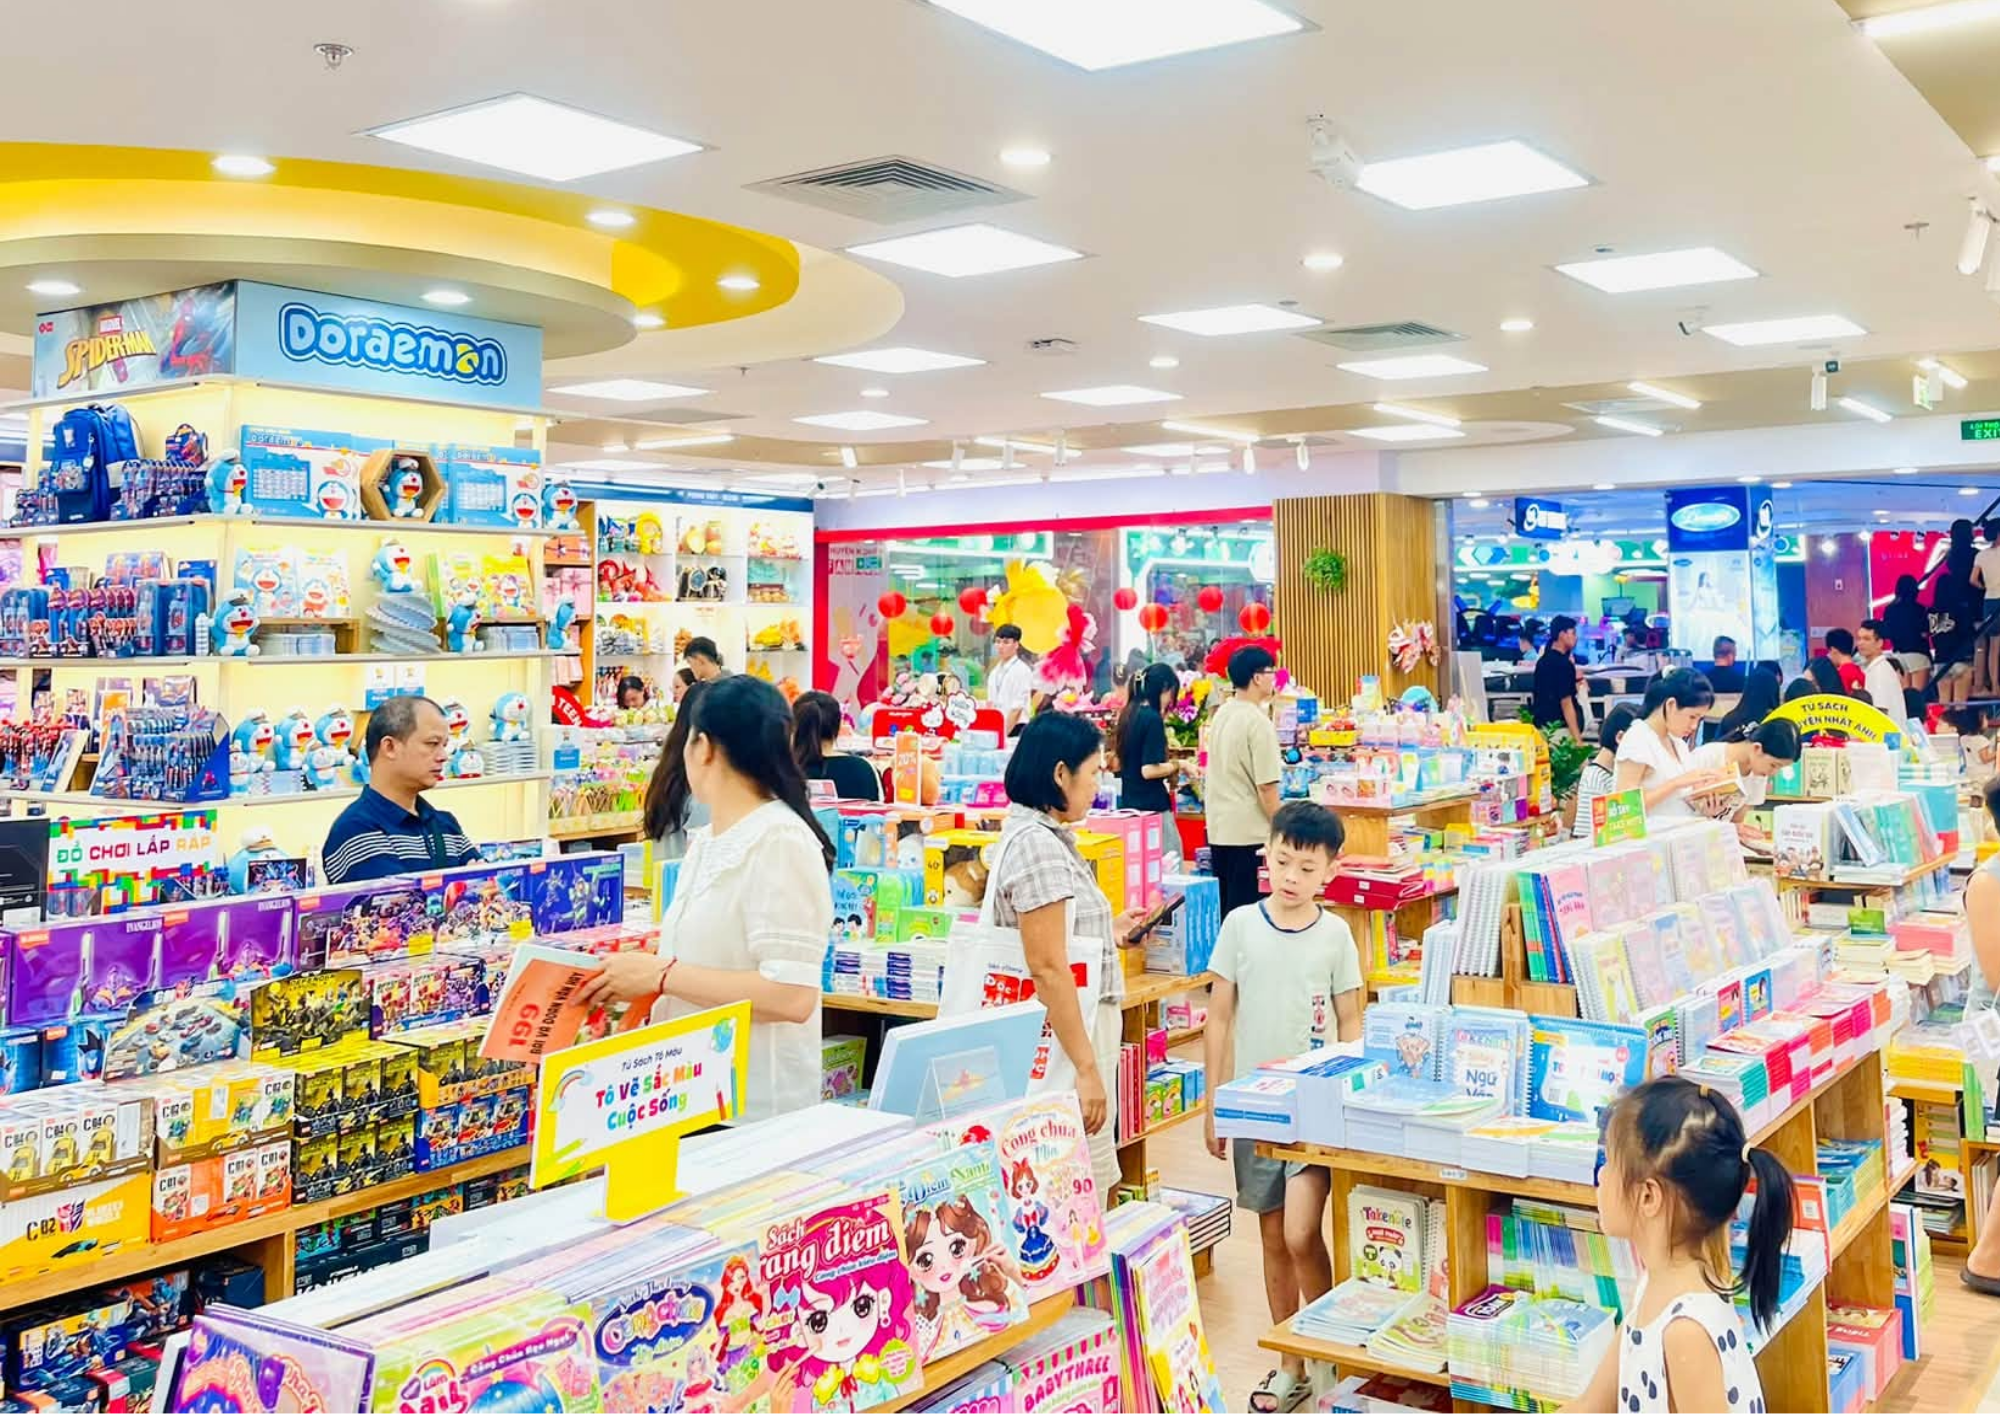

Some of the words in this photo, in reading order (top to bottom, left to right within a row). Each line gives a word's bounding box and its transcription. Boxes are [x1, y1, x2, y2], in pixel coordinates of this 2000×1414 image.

[57, 331, 157, 389] SPIDER-MAN
[284, 309, 503, 381] Doraemon
[89, 842, 131, 861] CHƠI
[137, 834, 170, 856] LẮP
[508, 1003, 541, 1047] 199
[595, 1084, 615, 1109] Tô
[619, 1076, 640, 1101] Vẽ
[643, 1063, 669, 1095] Sắc
[673, 1060, 702, 1084] Màu
[1466, 1067, 1498, 1088] Ngữ
[607, 1103, 645, 1130] Cuộc
[648, 1087, 688, 1117] Sống
[1073, 1178, 1092, 1194] 90
[769, 1217, 805, 1249] Sách
[1023, 1355, 1111, 1412] BABYTHREE
